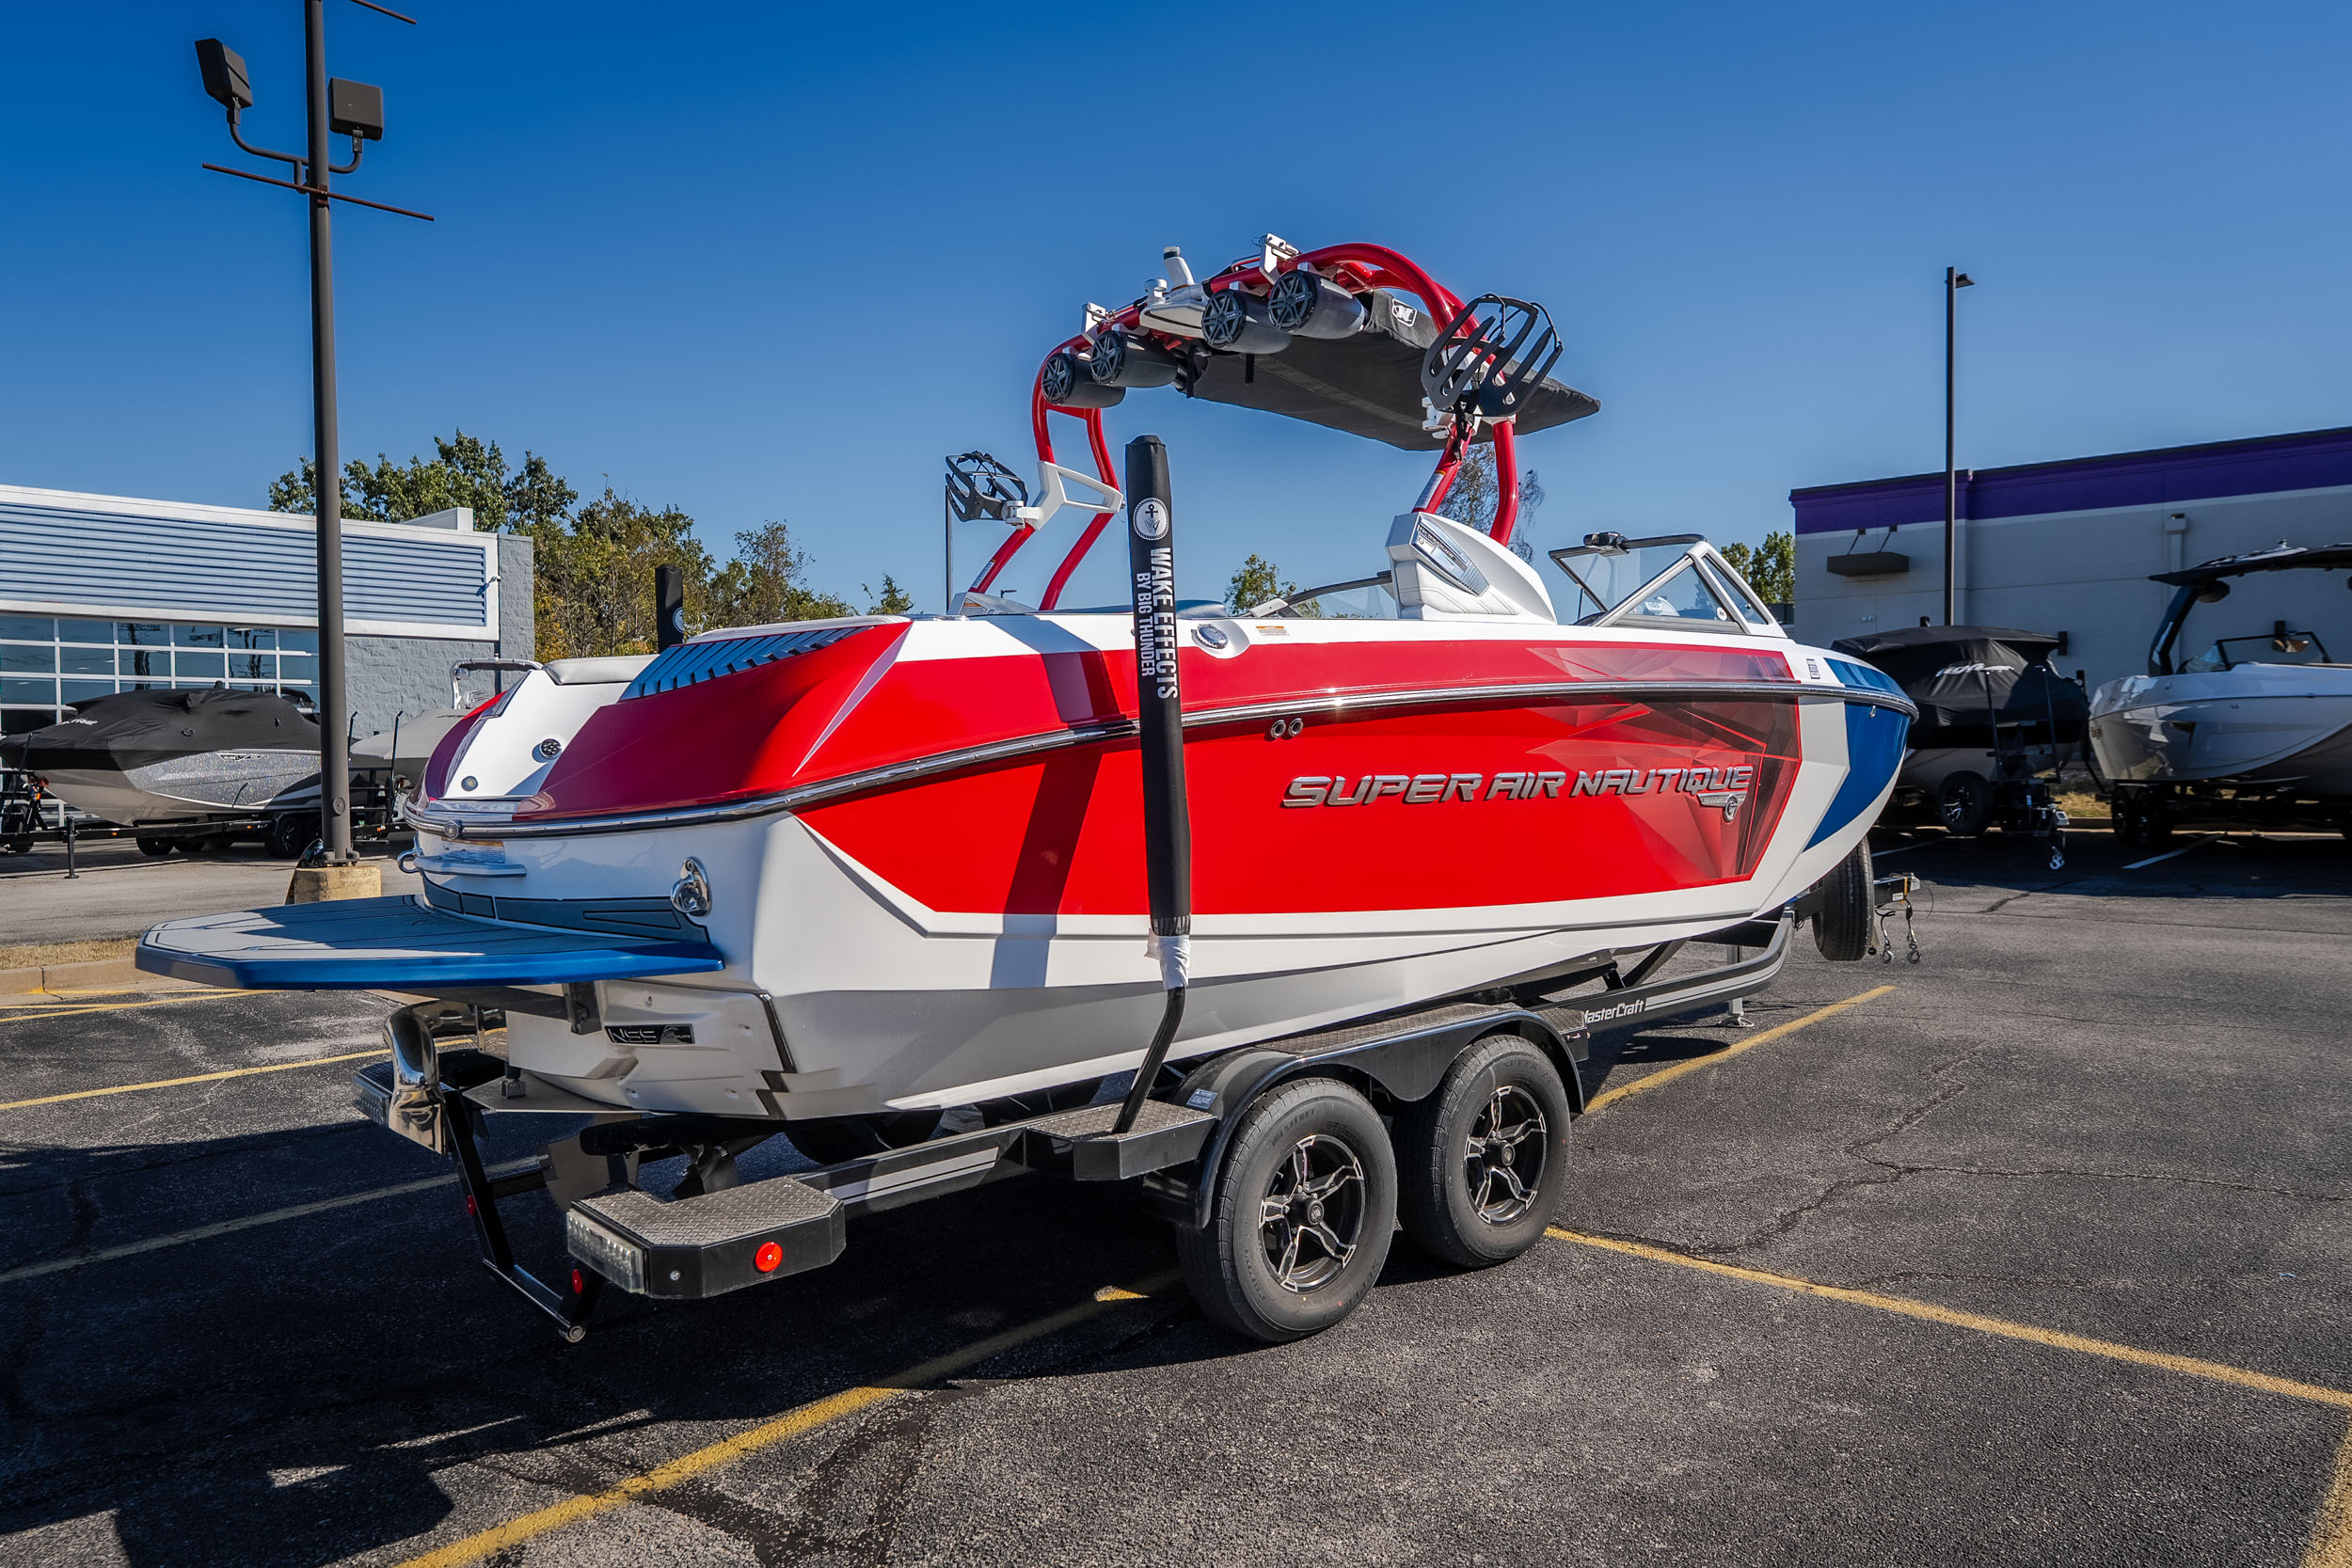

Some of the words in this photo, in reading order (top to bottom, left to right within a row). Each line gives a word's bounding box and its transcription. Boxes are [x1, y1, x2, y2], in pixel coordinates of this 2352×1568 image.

[1136, 572, 1152, 590] BY
[1151, 547, 1173, 607] WAKE
[1137, 592, 1152, 614] BIG
[1139, 616, 1155, 677] THUNDER
[1153, 611, 1178, 699] EFFECTS
[1281, 772, 1484, 808] SUPER
[1486, 770, 1566, 800] AIR
[1570, 766, 1754, 797] NAUTIQUE
